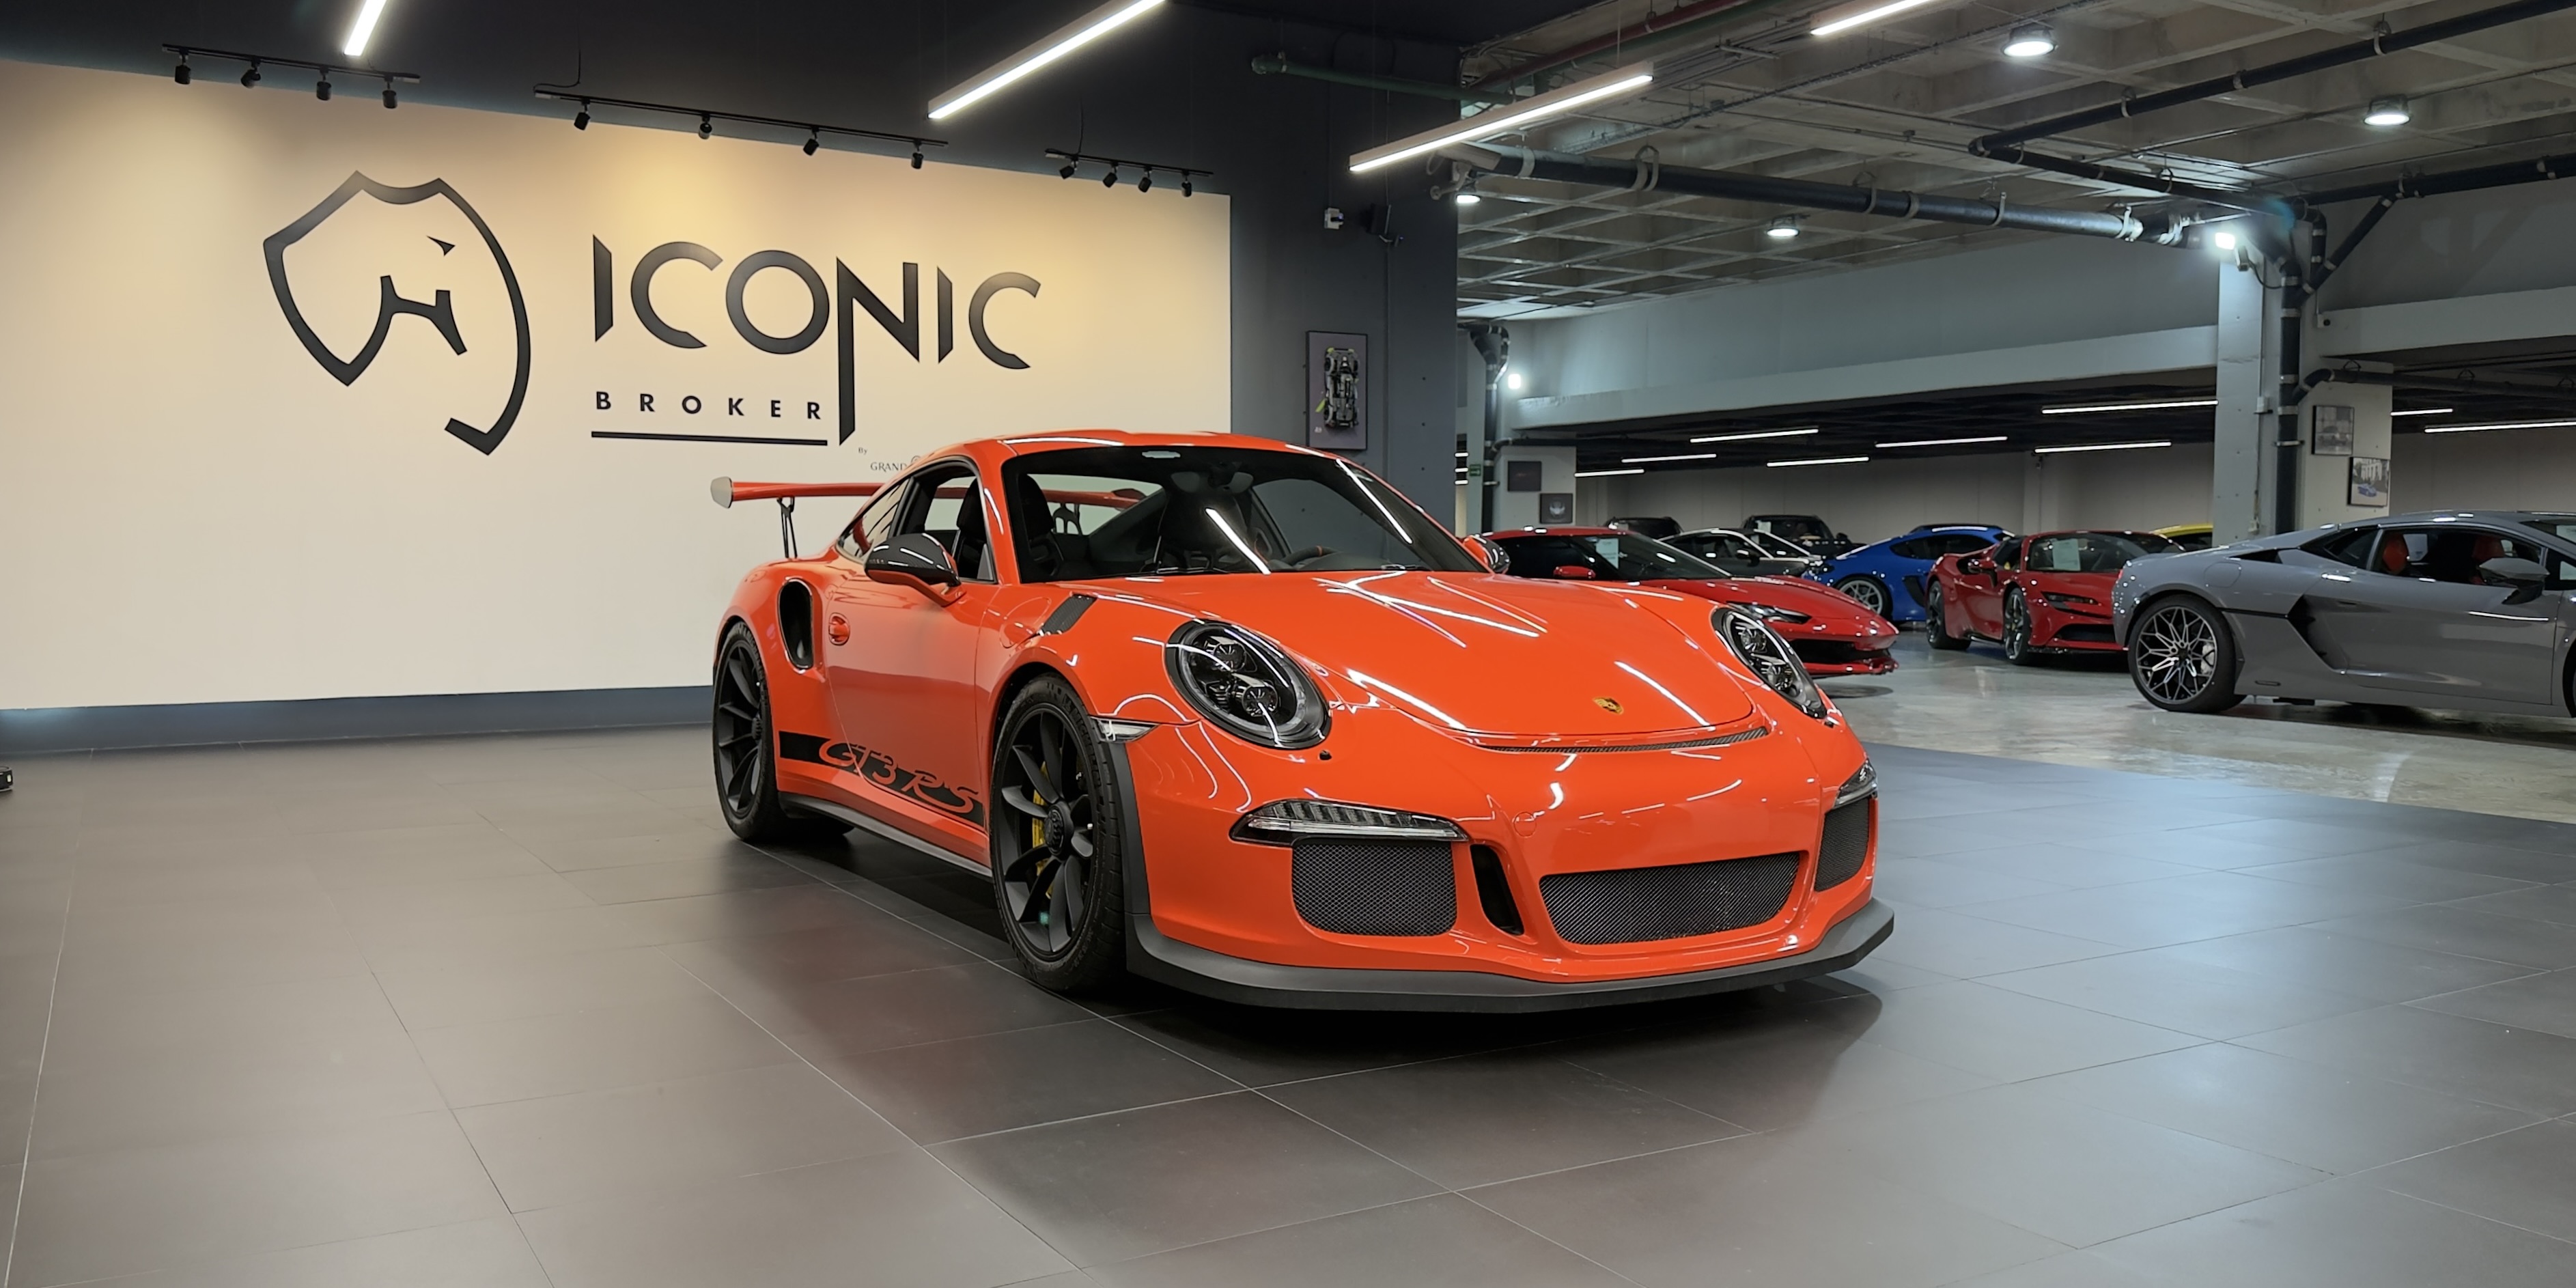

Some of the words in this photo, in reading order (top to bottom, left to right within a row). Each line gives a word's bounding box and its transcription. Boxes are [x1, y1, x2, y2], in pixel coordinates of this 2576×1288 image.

[592, 234, 1042, 446] ICONIC
[596, 391, 822, 420] BROKER
[858, 447, 868, 455] By
[820, 739, 899, 786] GT3
[903, 769, 981, 814] RS
